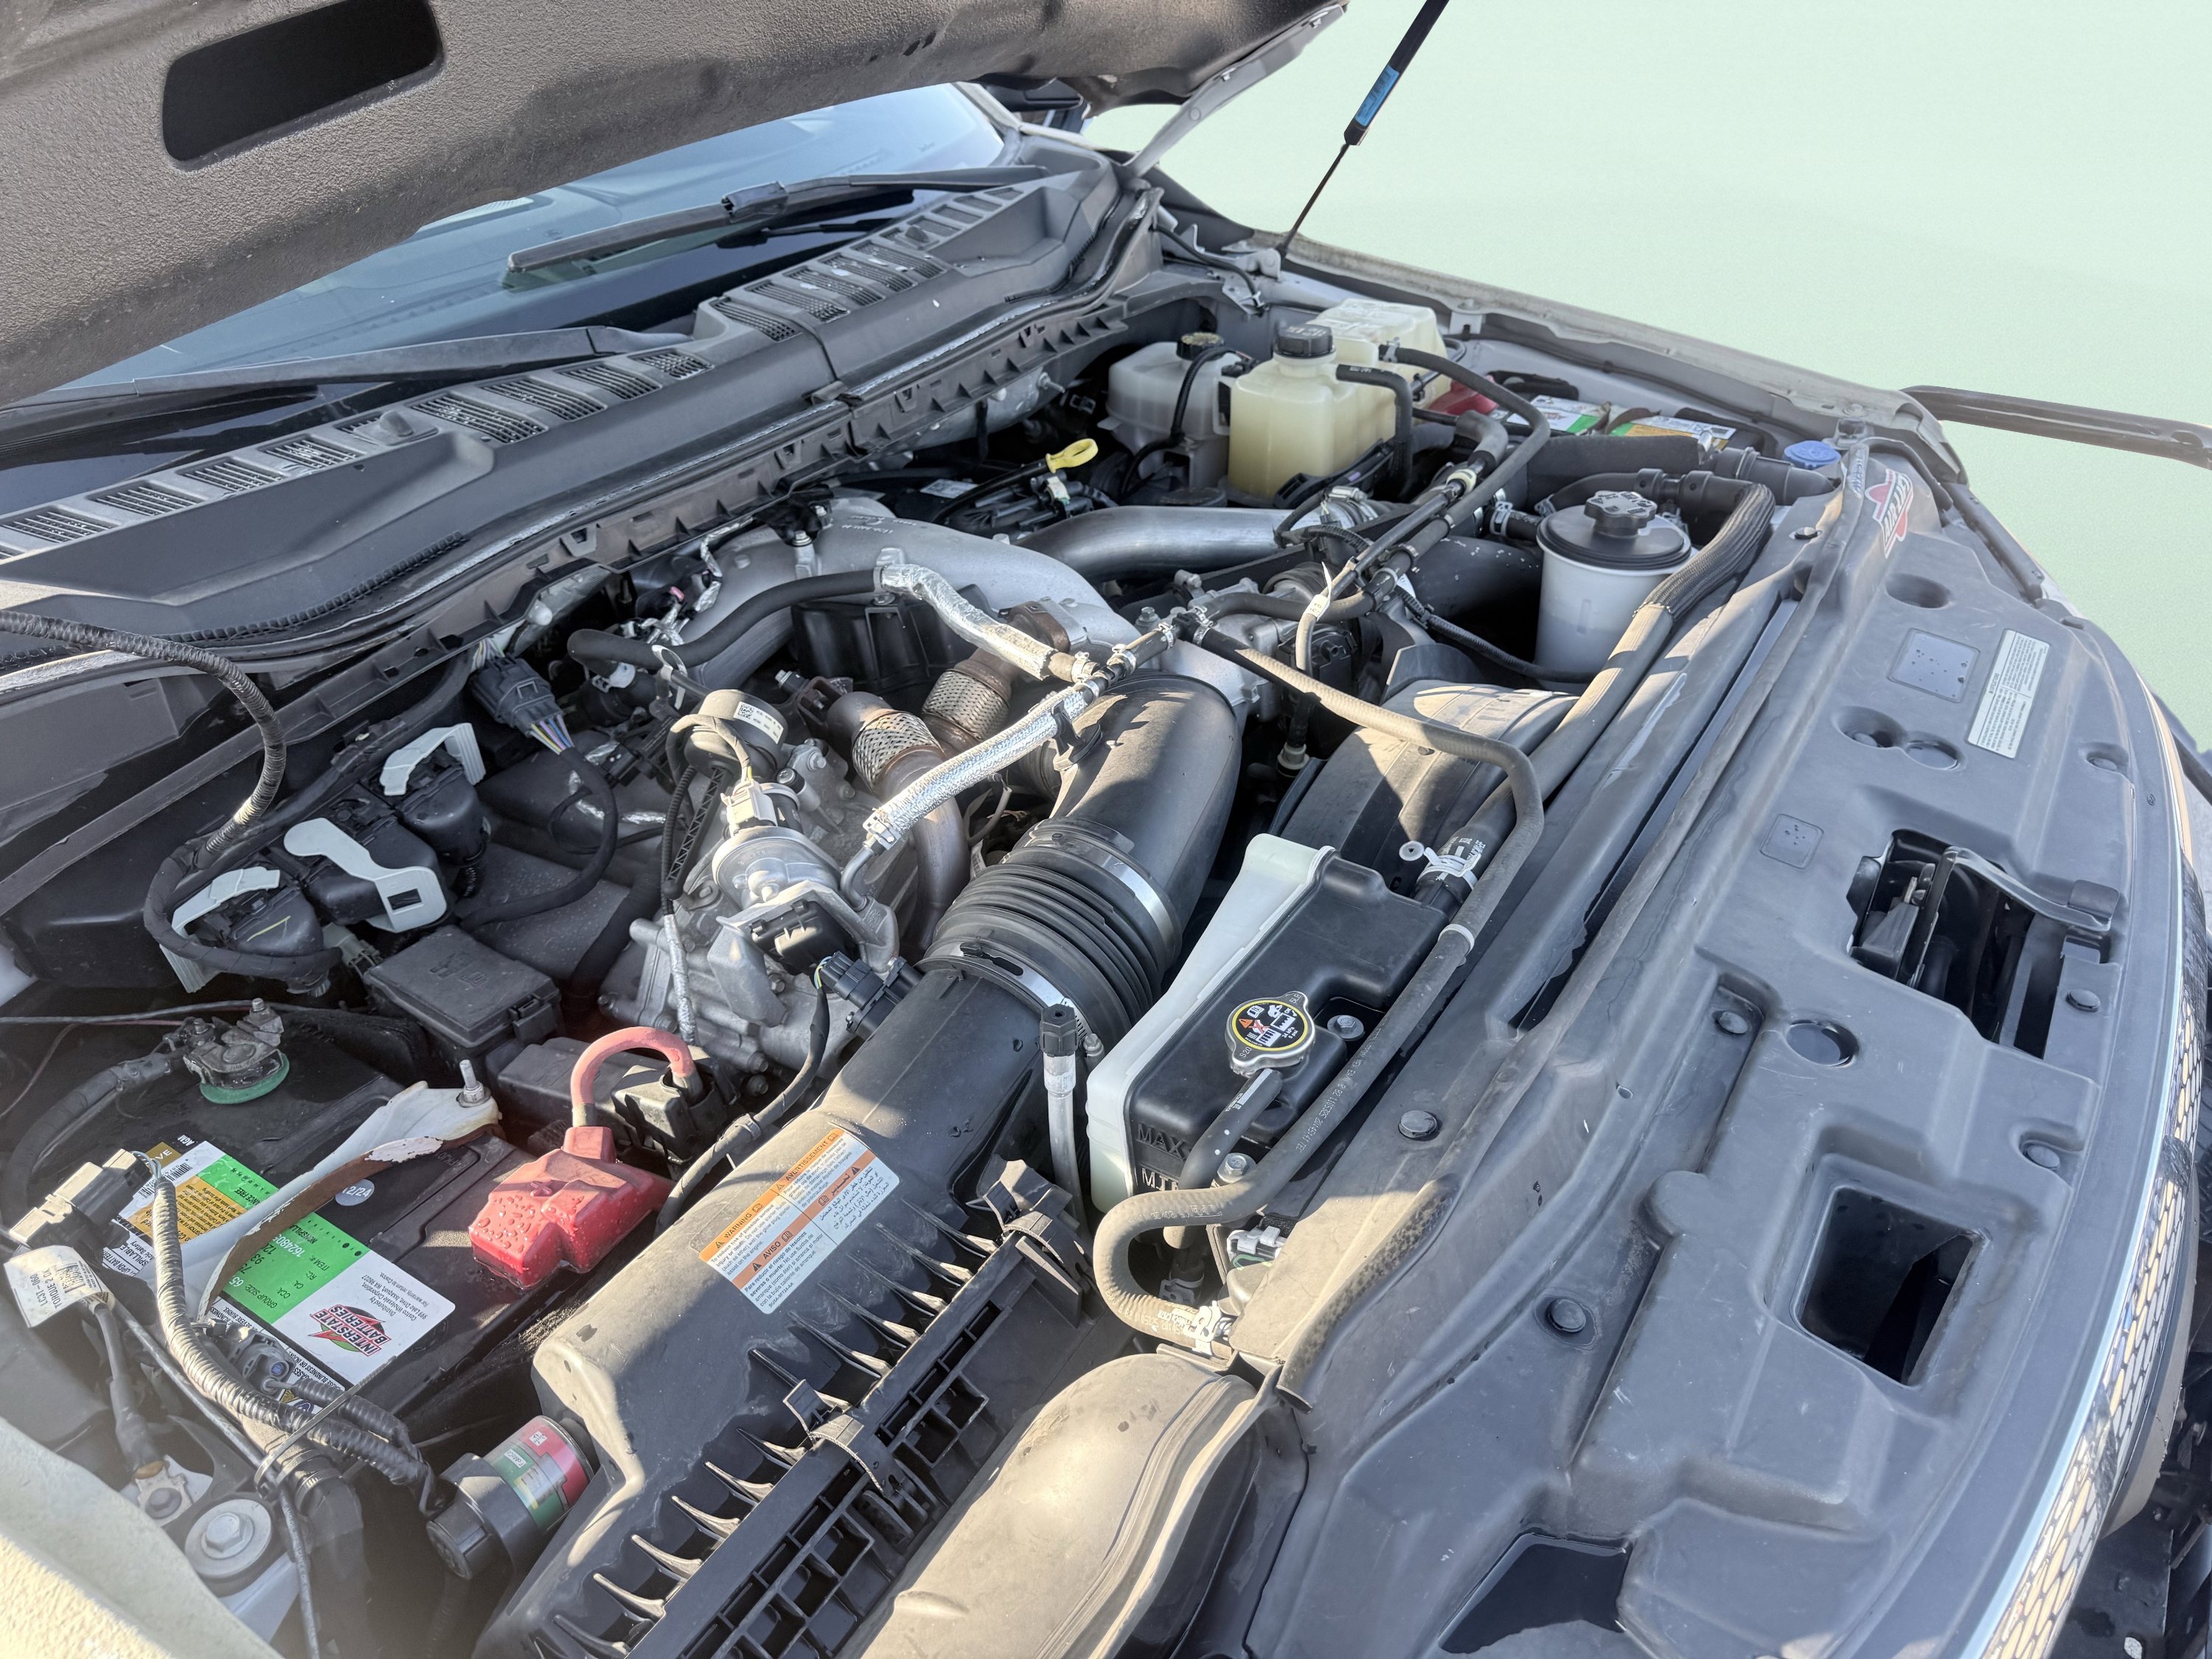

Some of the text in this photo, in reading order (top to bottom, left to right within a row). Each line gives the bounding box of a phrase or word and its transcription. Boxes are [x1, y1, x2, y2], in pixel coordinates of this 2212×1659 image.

[178, 1134, 195, 1147] AGM
[1137, 1121, 1187, 1162] MAX
[234, 1187, 249, 1198] FREE
[723, 1211, 752, 1239] WARNING
[762, 1240, 782, 1259] AVISO
[249, 1253, 305, 1289] CA: 93
[313, 1259, 330, 1270] ITEM
[304, 1270, 317, 1280] RC:
[361, 1274, 377, 1284] 98027
[46, 1281, 64, 1308] TORQUE
[243, 1284, 260, 1295] SIZE:
[275, 1287, 291, 1298] CCA:
[256, 1293, 278, 1308] GROUP
[372, 1299, 396, 1316] Distributed
[381, 1296, 403, 1312] Wholesale
[400, 1309, 417, 1321] Costco
[407, 1305, 420, 1314] Lake
[417, 1311, 428, 1319] 999
[329, 1304, 388, 1345] BATTERIES
[313, 1310, 378, 1354] INTERSTATE
